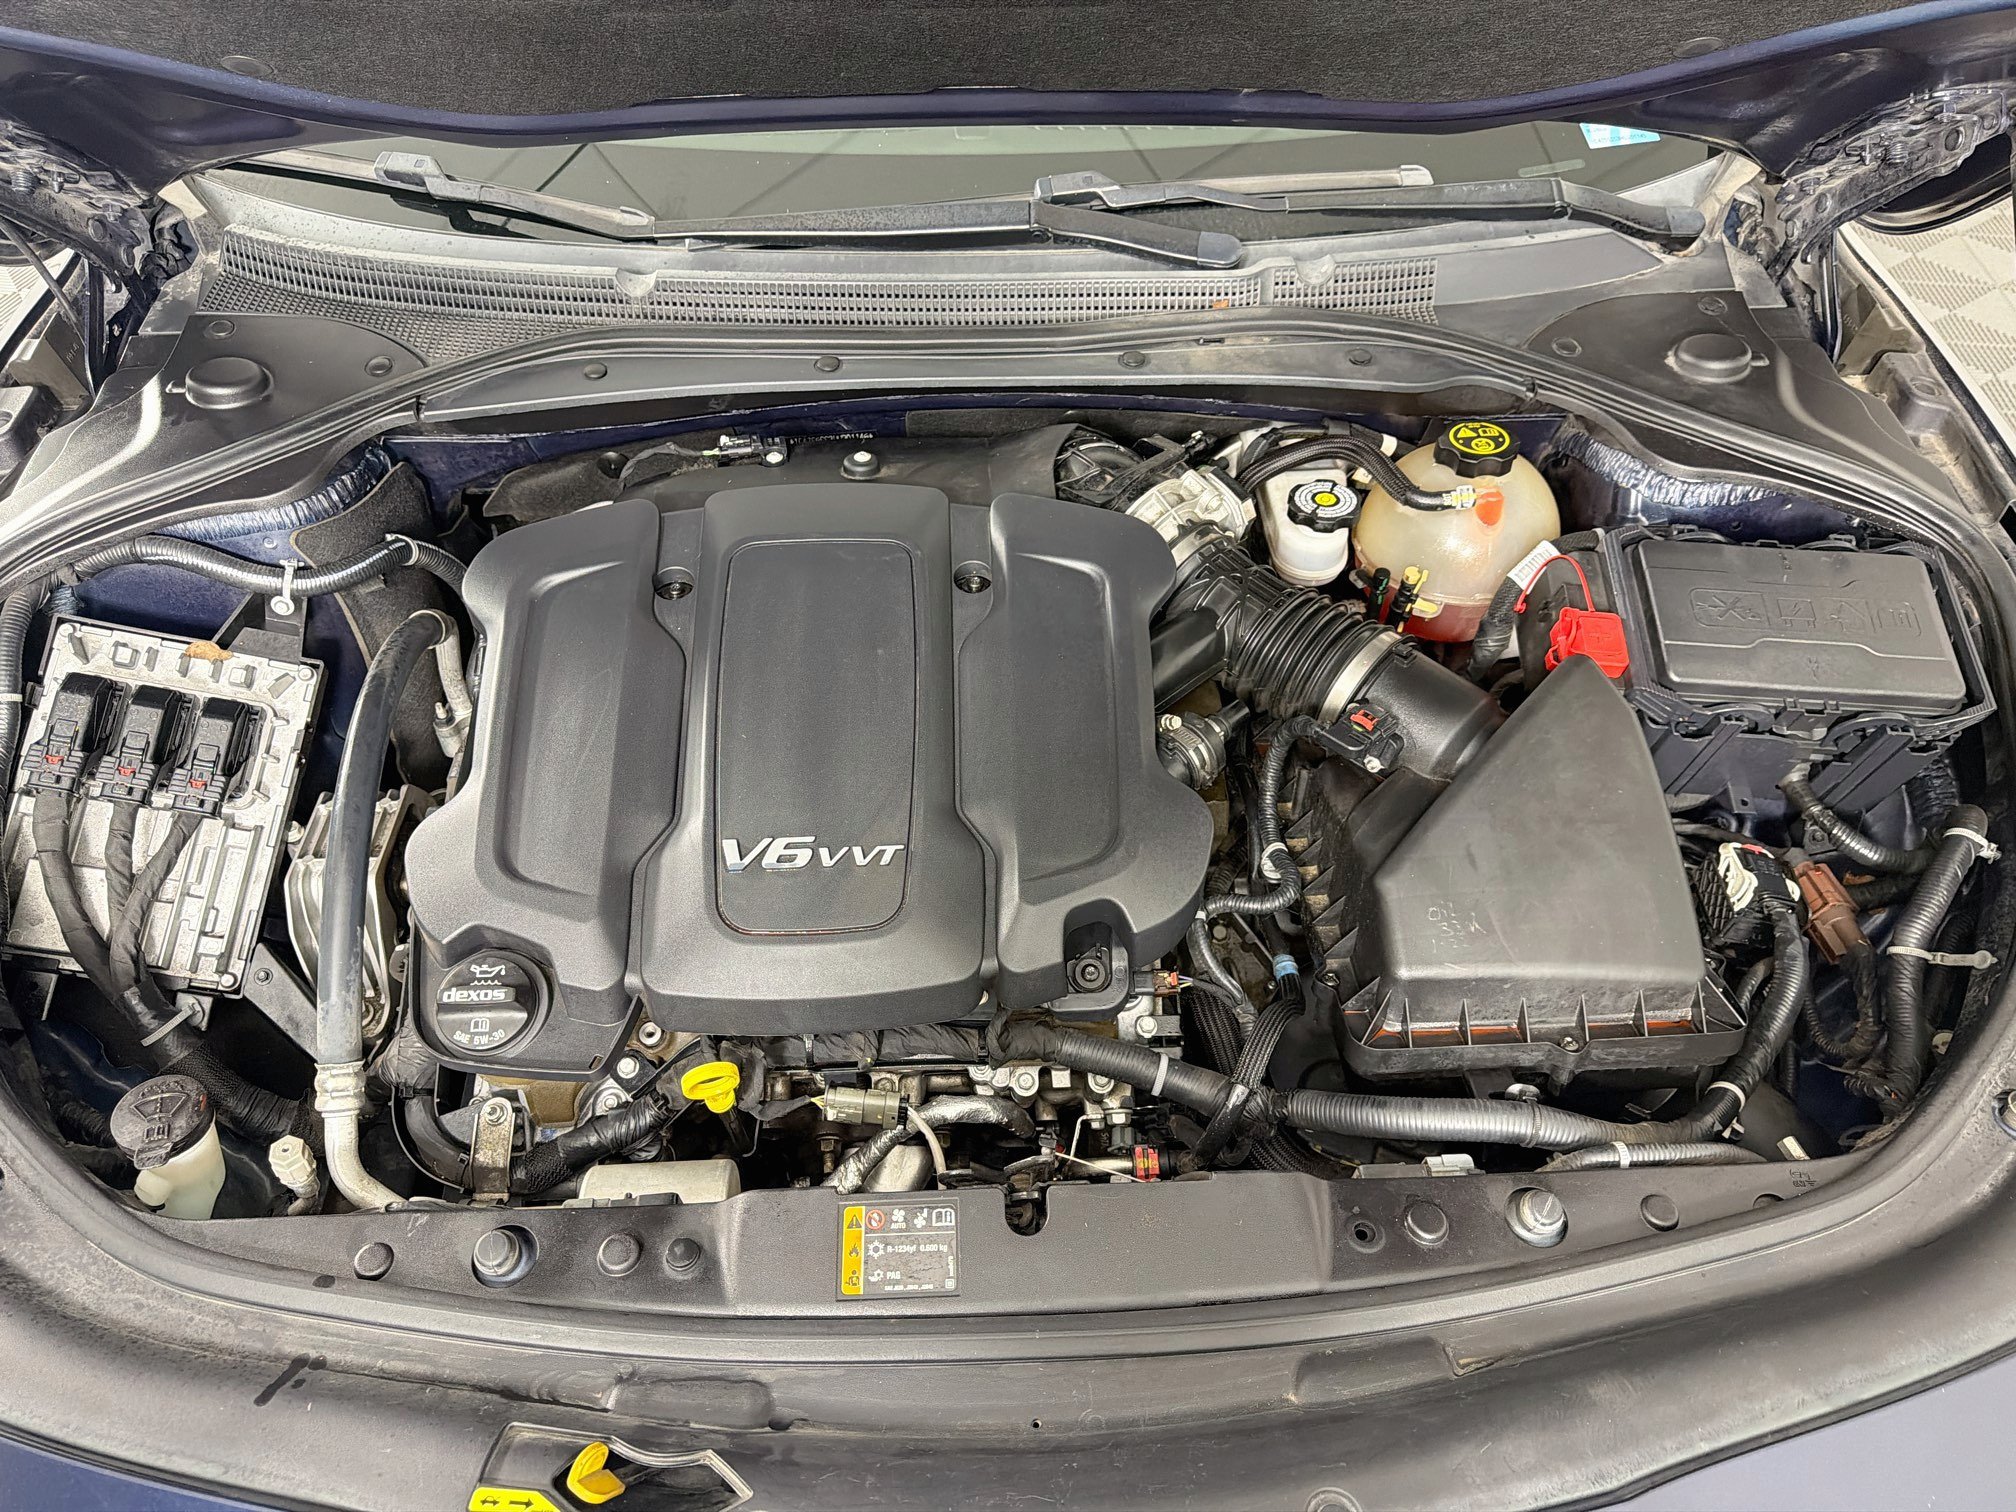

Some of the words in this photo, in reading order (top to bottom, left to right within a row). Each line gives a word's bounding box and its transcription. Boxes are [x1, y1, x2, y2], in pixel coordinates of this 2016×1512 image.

[721, 836, 816, 871] V6
[819, 844, 905, 867] VVT
[442, 987, 506, 1003] dexos
[453, 1030, 471, 1044] SAE
[939, 1243, 948, 1253] kg
